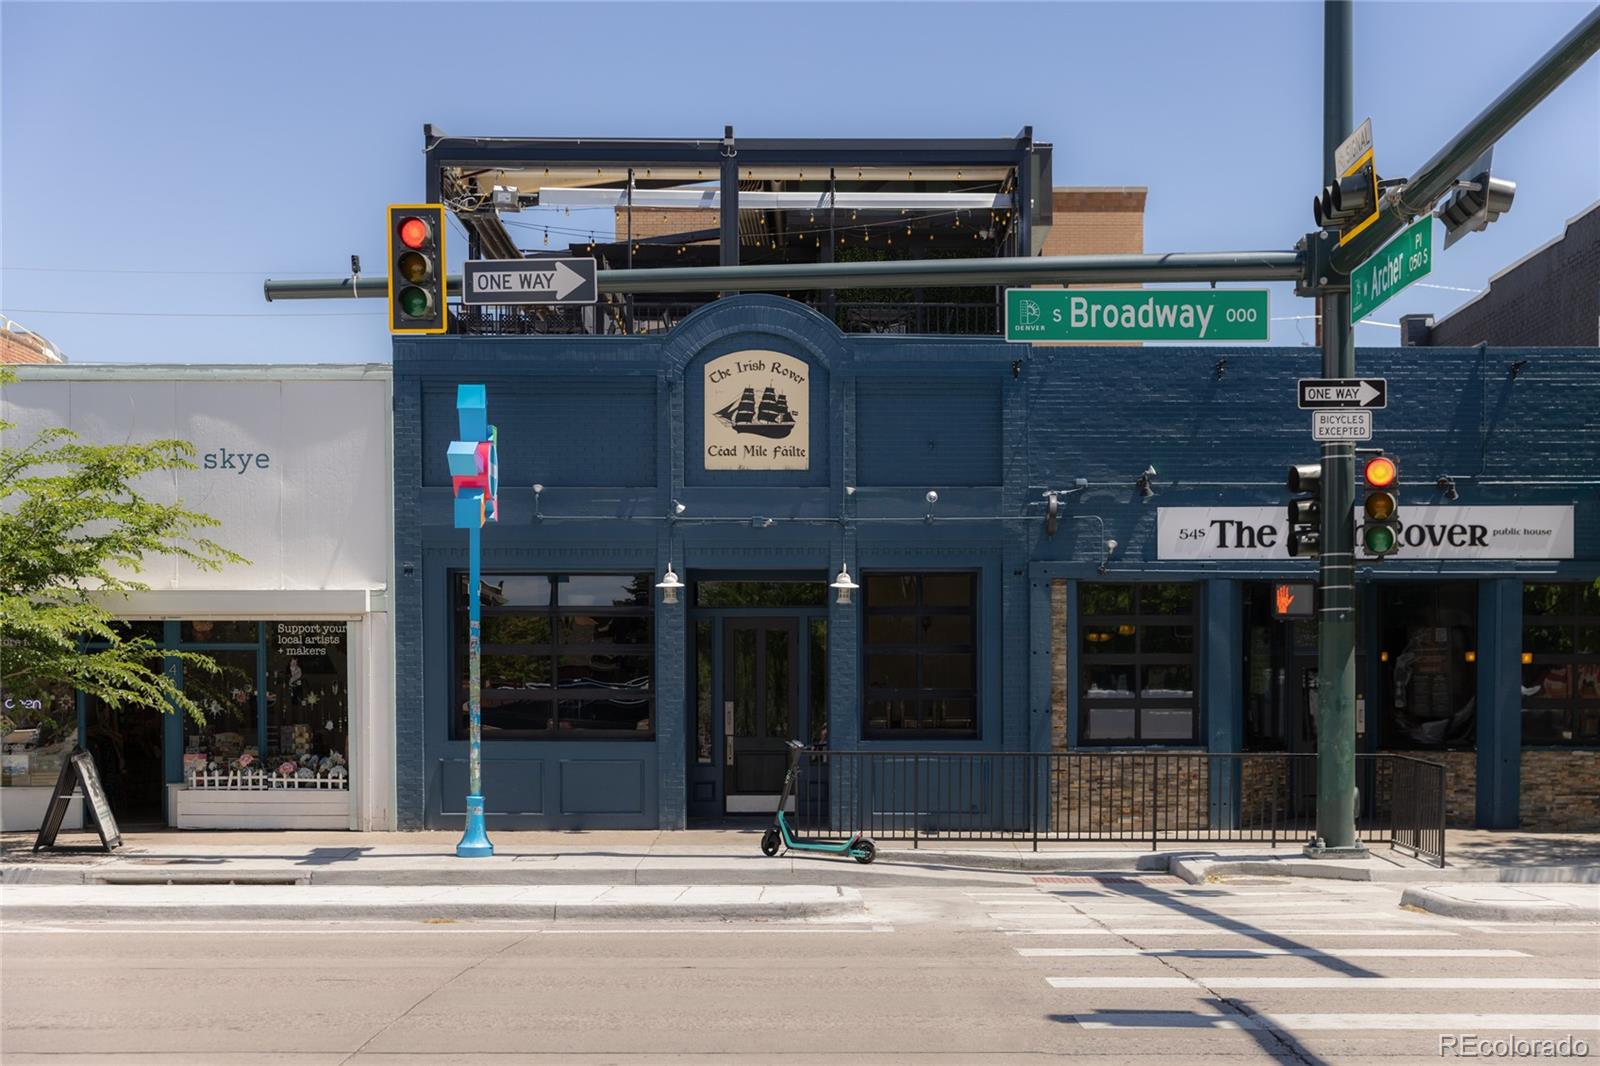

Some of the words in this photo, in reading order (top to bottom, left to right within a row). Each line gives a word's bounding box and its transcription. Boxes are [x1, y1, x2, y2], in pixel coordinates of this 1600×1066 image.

[1423, 248, 1429, 264] S
[478, 273, 512, 290] ONE
[519, 273, 555, 289] WAY
[1371, 252, 1404, 301] Archer
[1053, 308, 1062, 322] S
[1070, 296, 1214, 338] Broadway
[708, 368, 732, 384] The
[735, 360, 766, 373] Irish
[771, 361, 805, 384] Rover
[1308, 388, 1331, 399] ONE
[1336, 388, 1359, 399] WAY
[1320, 415, 1364, 424] BICYCLES
[1319, 427, 1365, 436] EXCEPTED
[204, 448, 270, 475] skye
[1209, 519, 1278, 549] The
[1492, 527, 1521, 537] public
[1523, 527, 1552, 536] house
[277, 623, 321, 635] Support
[322, 625, 348, 635] your
[278, 635, 303, 644] local
[304, 635, 340, 644] artists
[286, 646, 327, 656] makers
